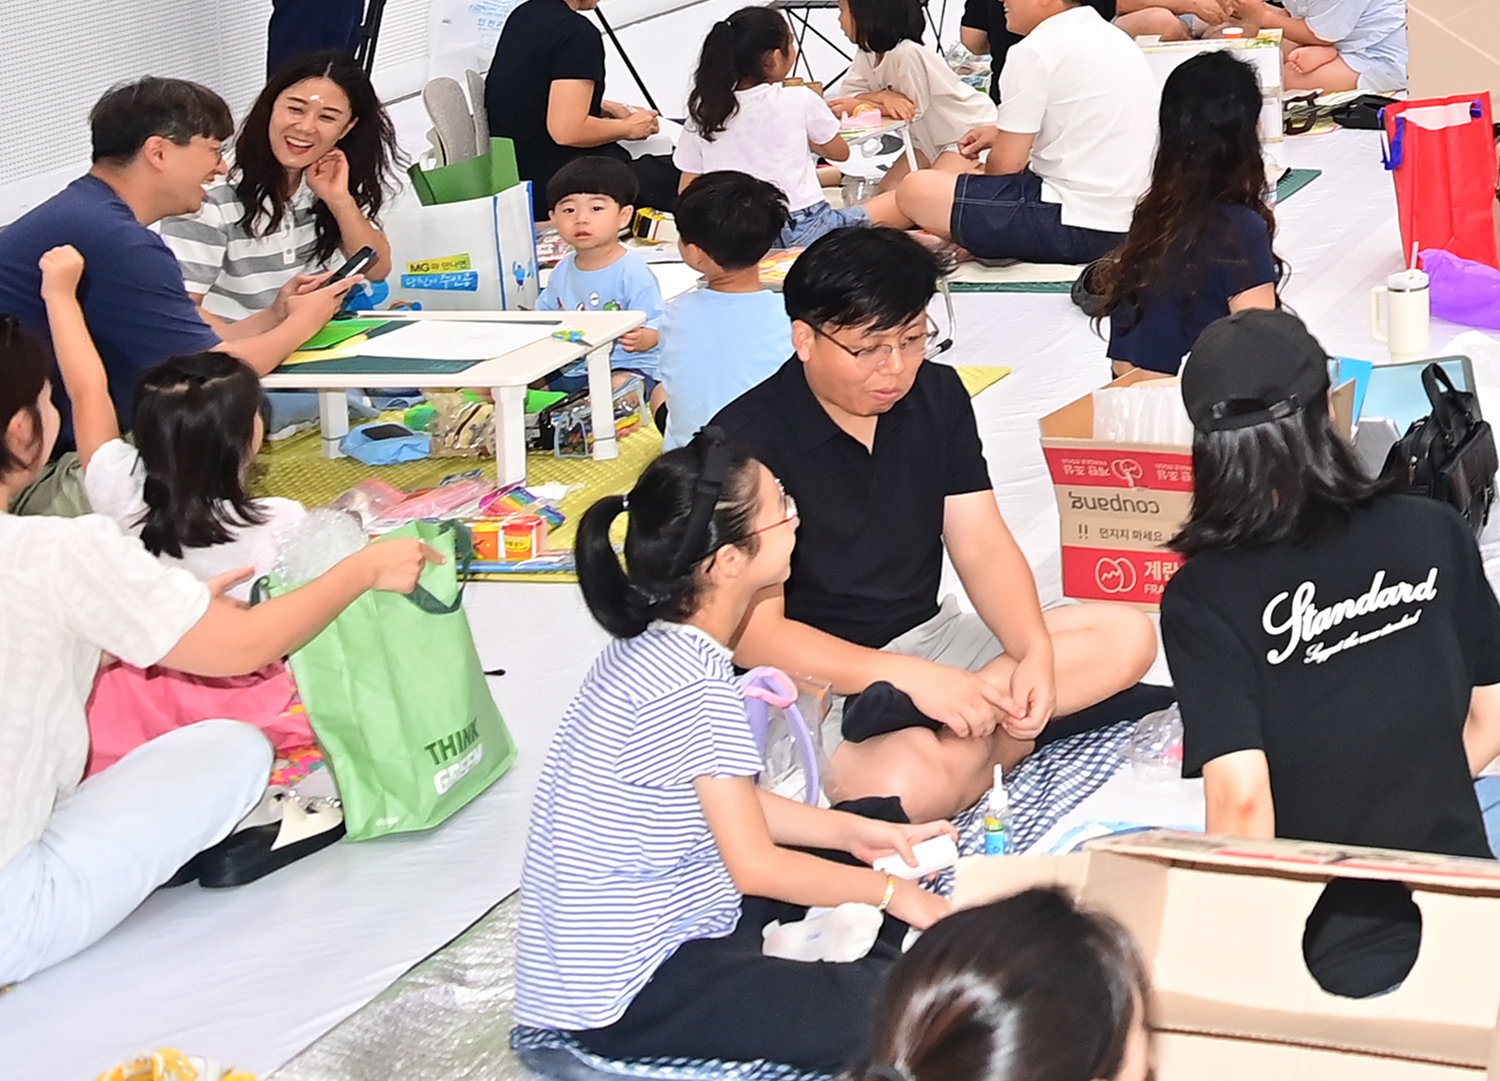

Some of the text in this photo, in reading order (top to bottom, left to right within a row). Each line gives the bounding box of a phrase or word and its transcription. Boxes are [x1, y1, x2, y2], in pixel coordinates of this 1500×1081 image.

[1068, 490, 1160, 514] coupang
[1099, 527, 1130, 541] 던지지
[1132, 530, 1163, 542] 마세요
[1262, 566, 1439, 665] Standard
[423, 716, 480, 766] THINK
